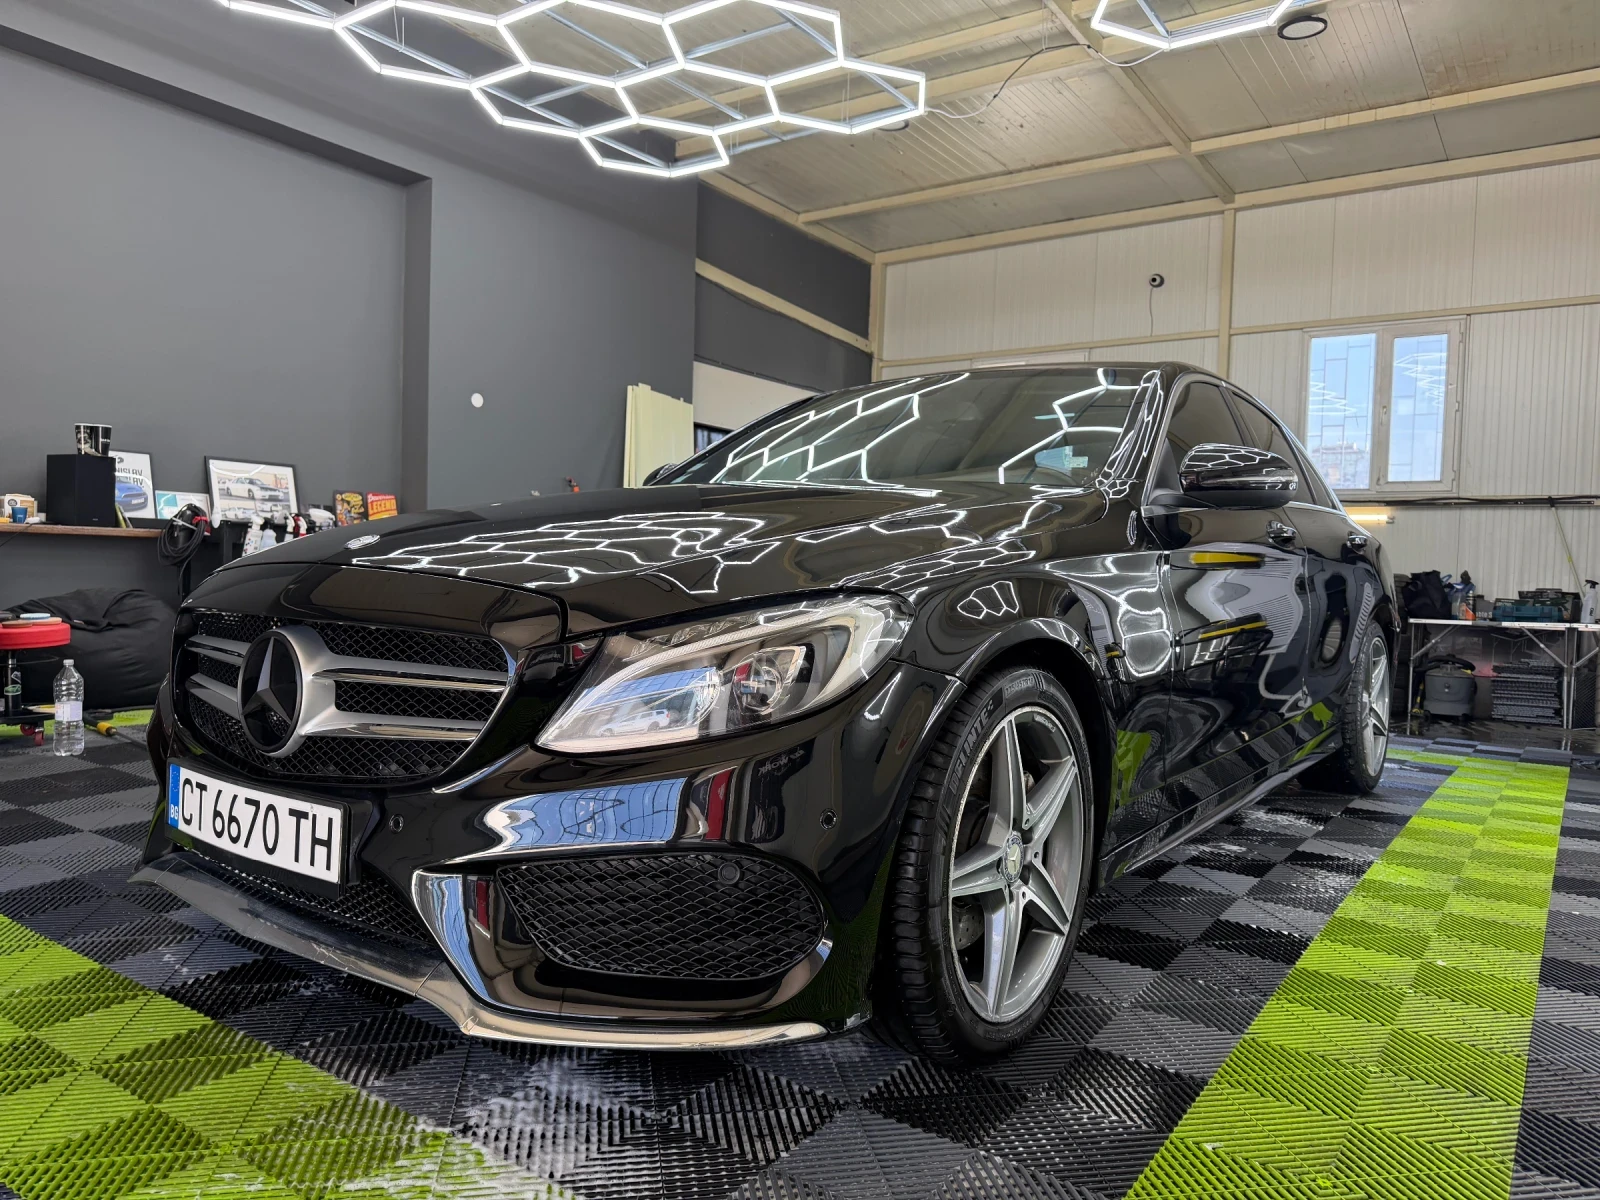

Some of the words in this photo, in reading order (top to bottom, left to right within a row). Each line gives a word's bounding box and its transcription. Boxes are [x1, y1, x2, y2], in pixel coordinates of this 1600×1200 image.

[170, 804, 179, 820] BG
[181, 777, 208, 832] CT
[212, 789, 280, 856] 6670
[288, 808, 334, 872] TH
